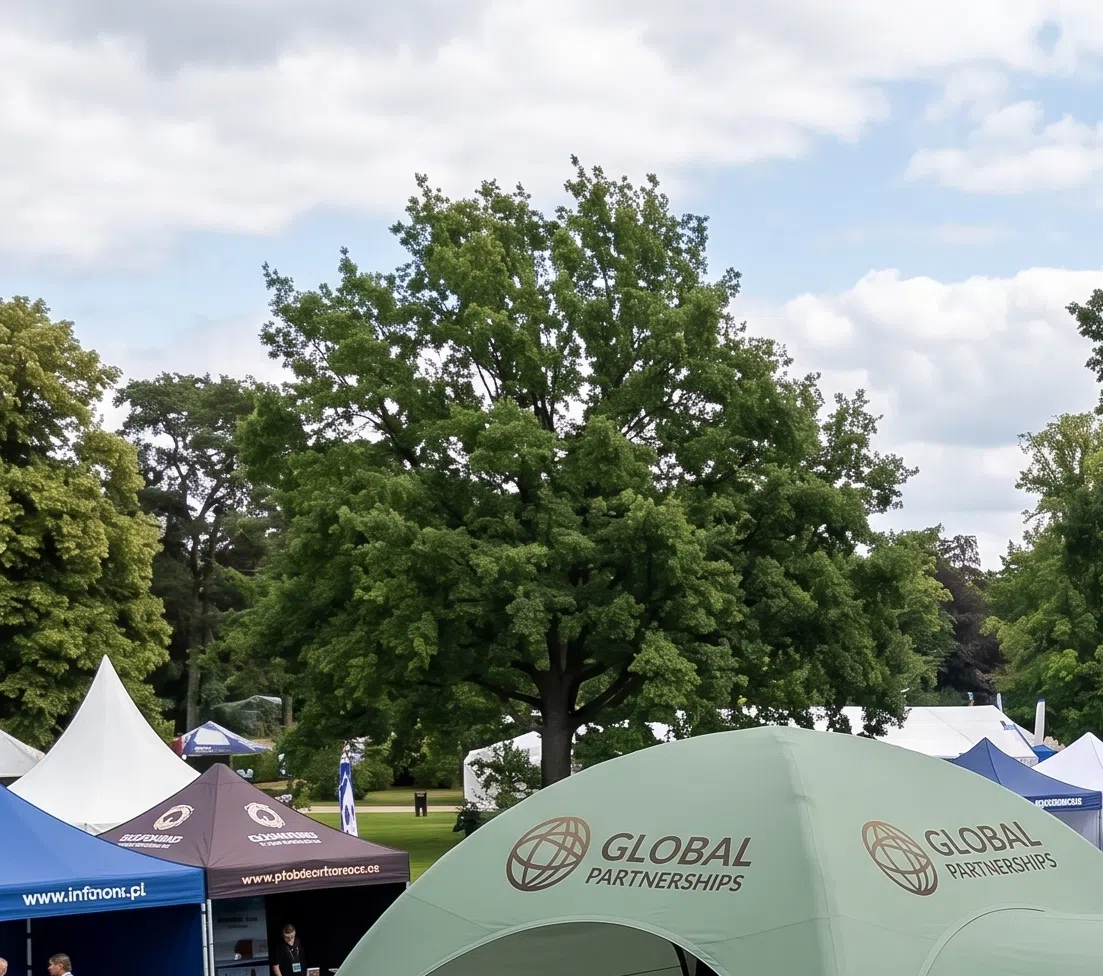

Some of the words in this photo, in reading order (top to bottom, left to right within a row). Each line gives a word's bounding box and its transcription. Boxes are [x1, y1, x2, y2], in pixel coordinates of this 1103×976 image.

[601, 832, 753, 867] GLOBAL
[924, 821, 1043, 857] GLOBAL
[584, 867, 745, 893] PARTNERSHIPS
[945, 852, 1058, 880] PARTNERSHIPS
